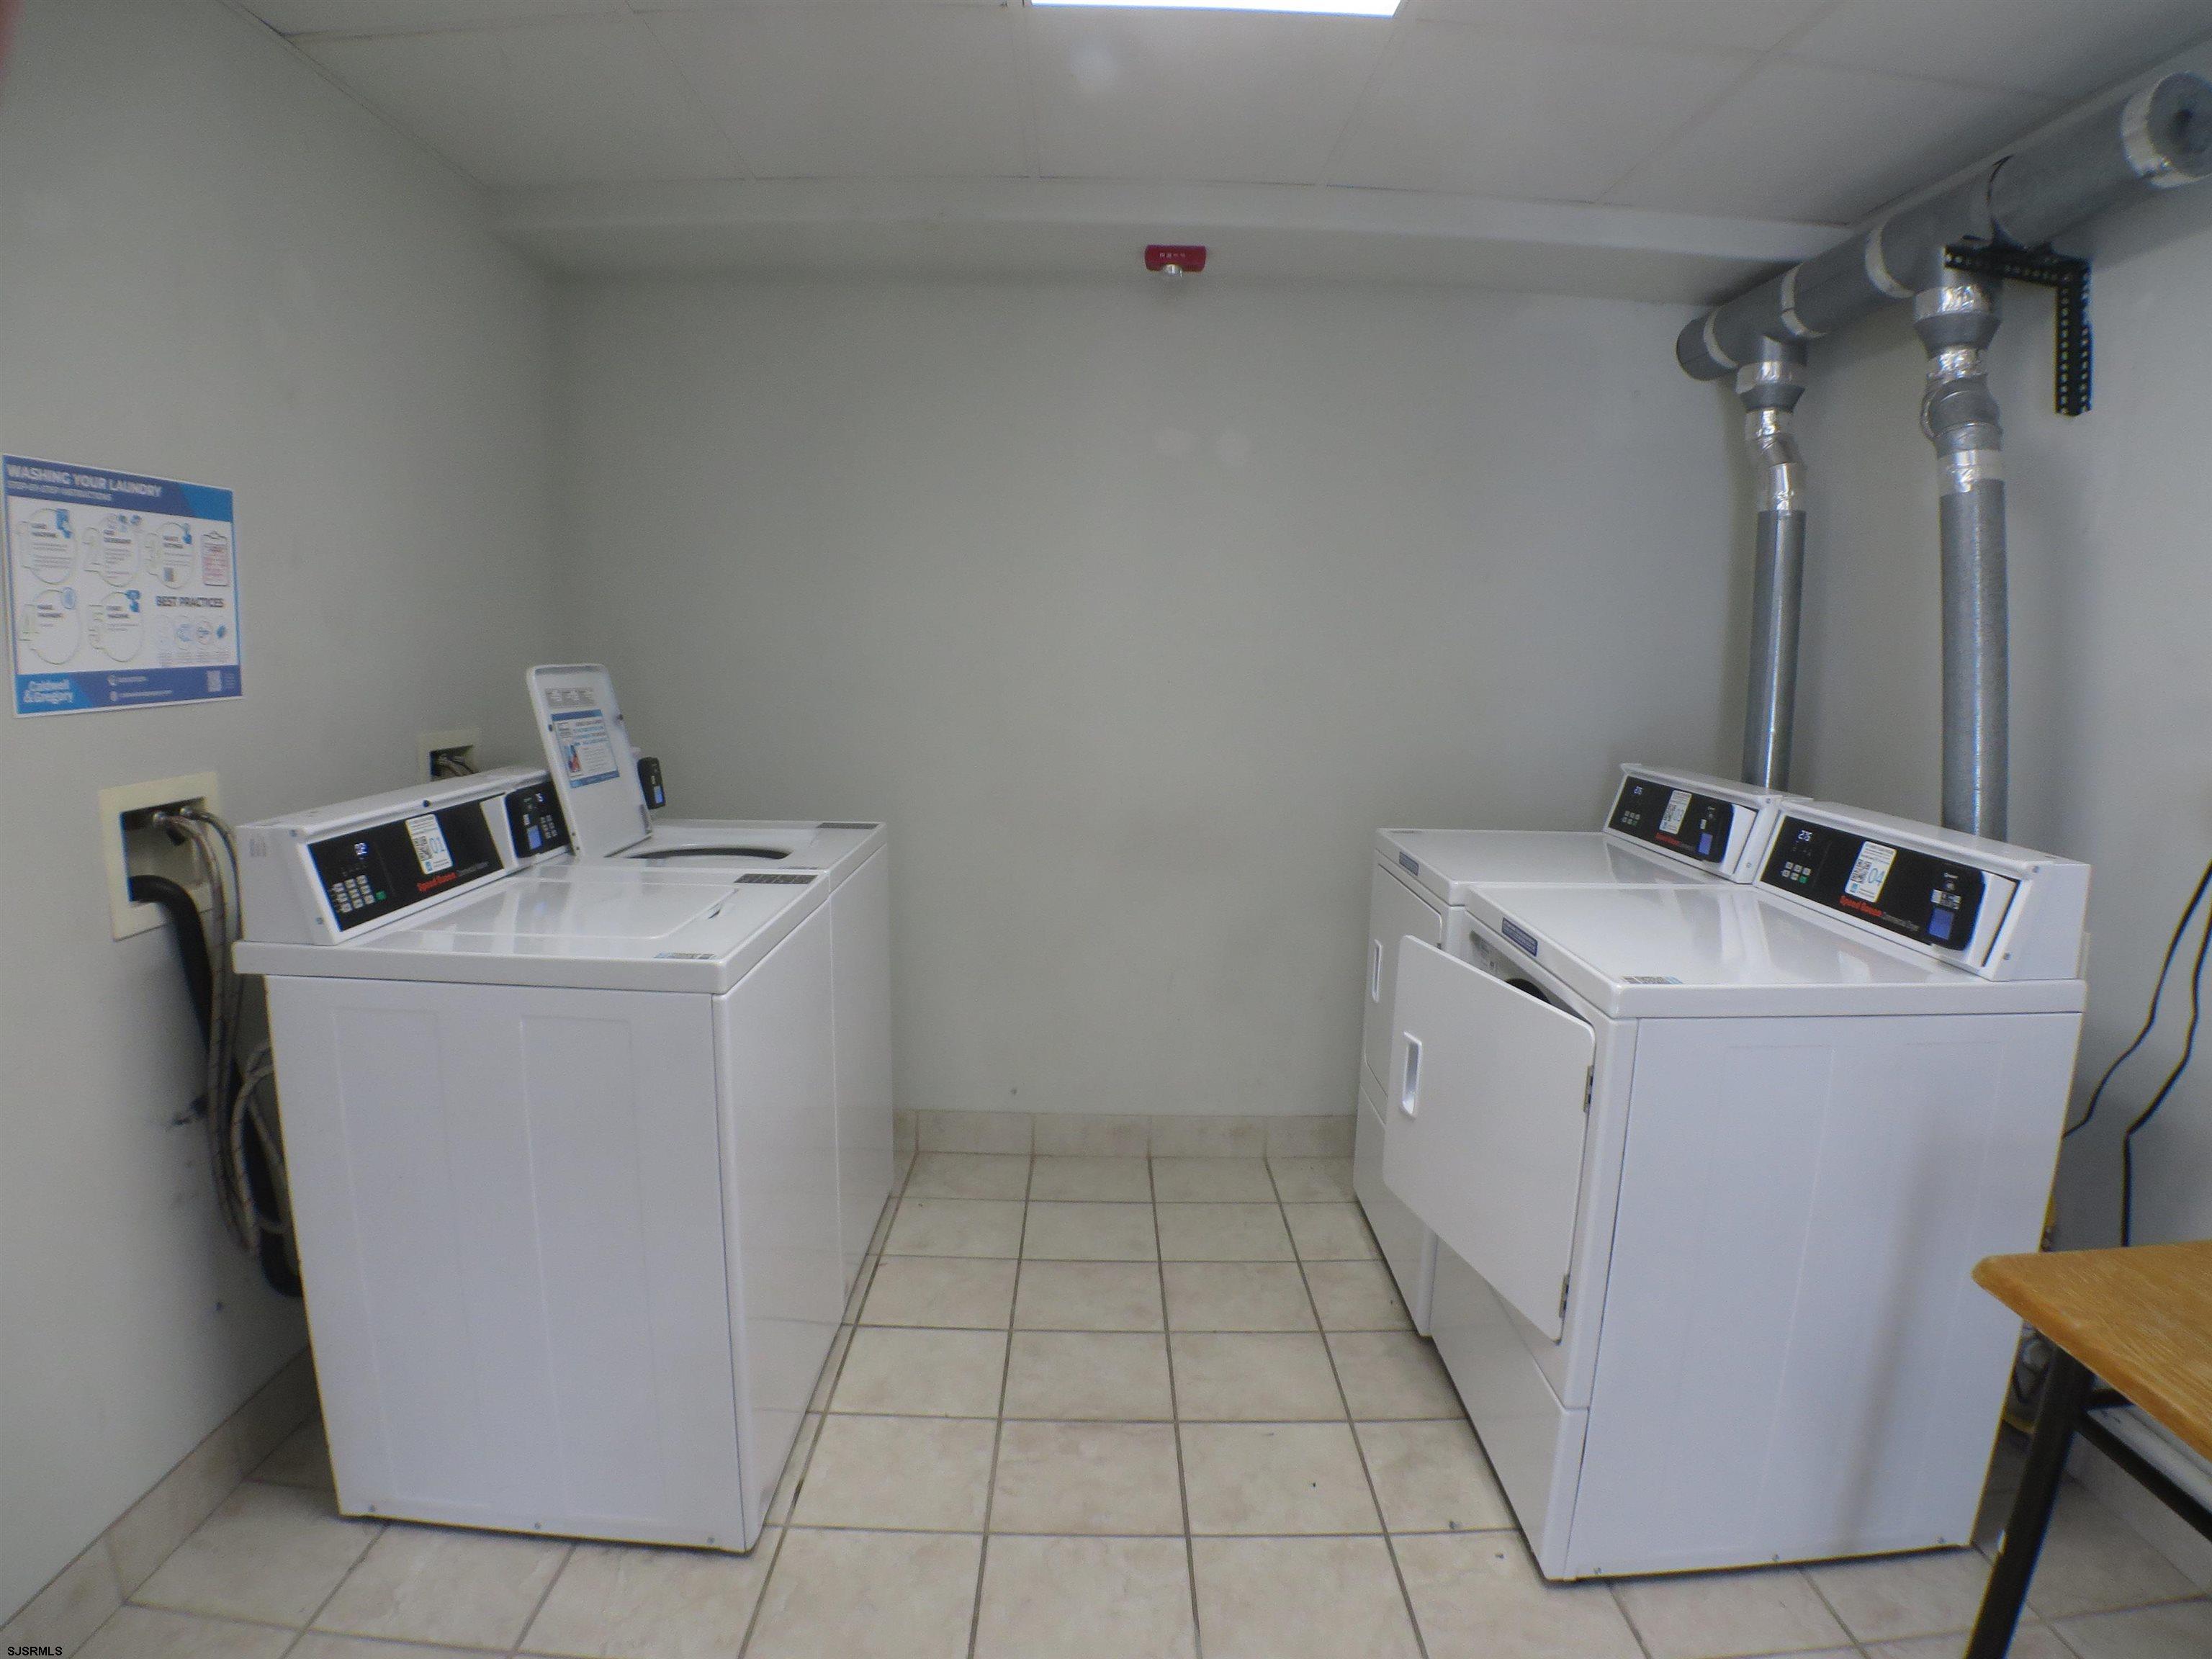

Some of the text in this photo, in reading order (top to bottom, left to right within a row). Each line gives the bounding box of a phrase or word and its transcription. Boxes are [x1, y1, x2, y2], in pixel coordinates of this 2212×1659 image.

[7, 464, 162, 498] WASHING YOUR LAUNDRY
[155, 595, 225, 608] BEST PRACTICES
[1868, 867, 1887, 886] 04
